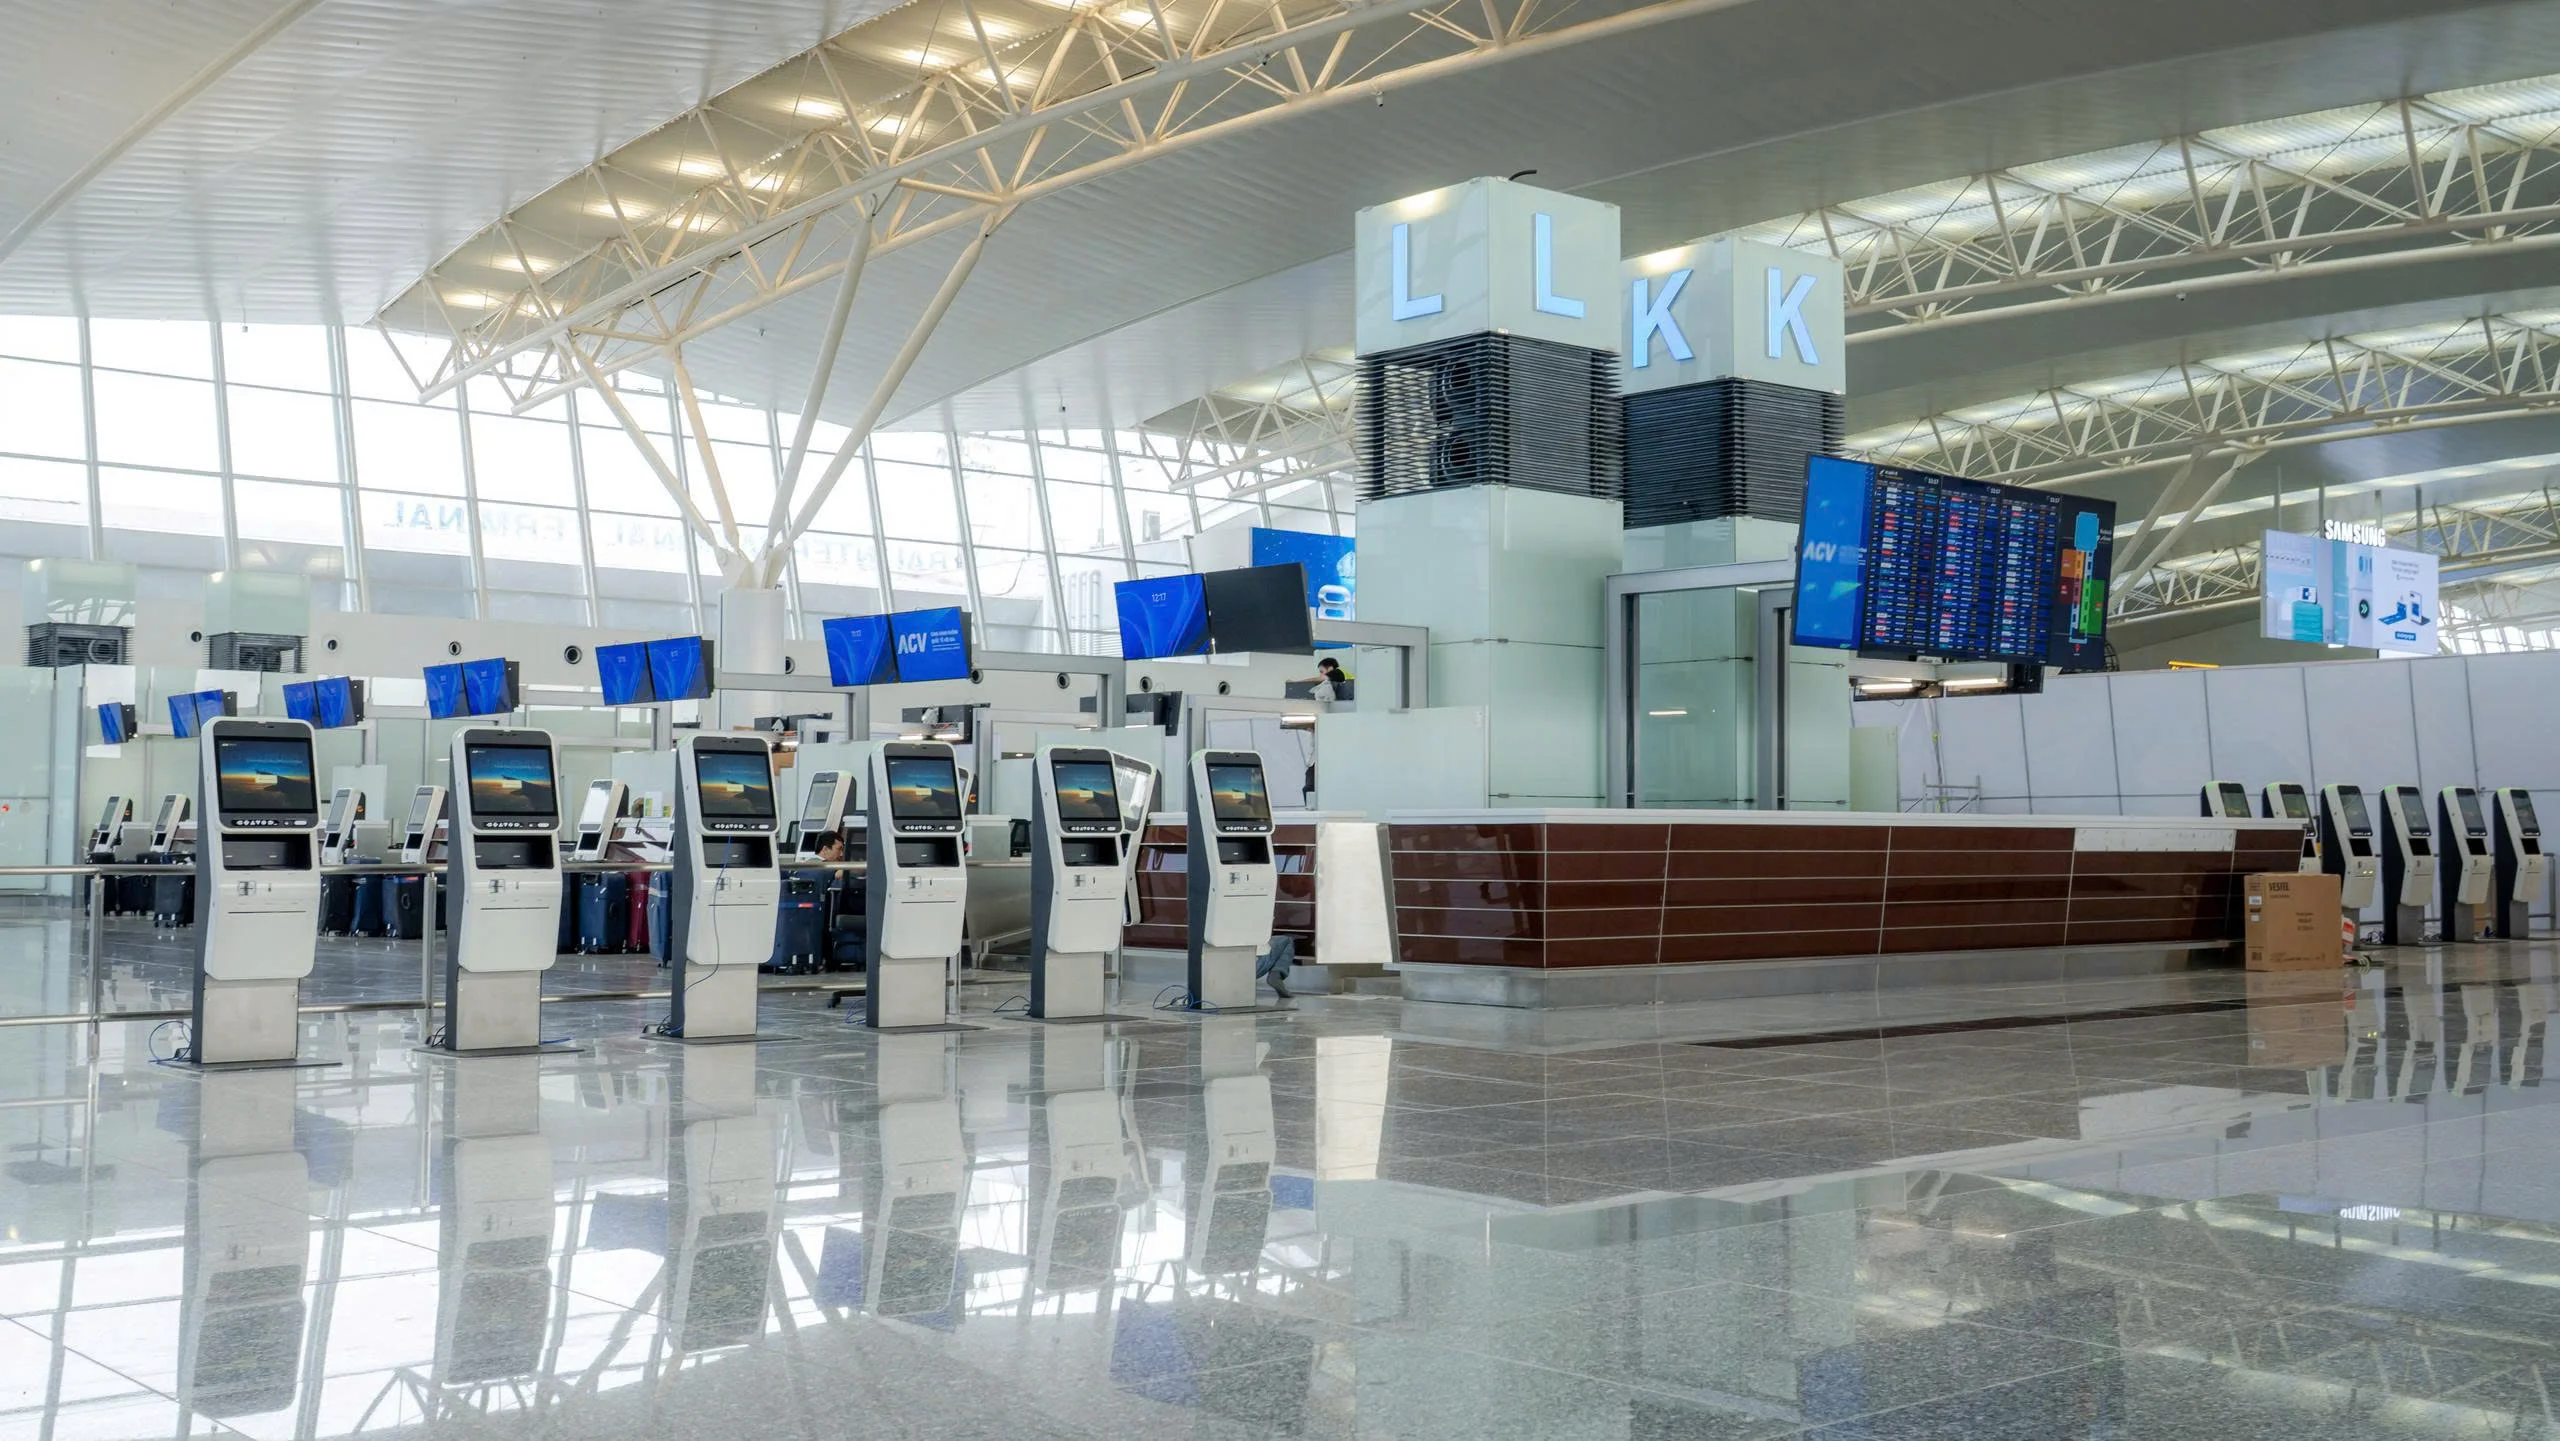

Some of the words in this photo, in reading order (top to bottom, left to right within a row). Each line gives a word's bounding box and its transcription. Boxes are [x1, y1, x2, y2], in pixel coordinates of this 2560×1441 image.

[1391, 222, 1444, 321] L
[1534, 212, 1586, 319] L
[1631, 267, 1696, 369] K
[1767, 266, 1820, 366] K
[2324, 519, 2387, 548] SAMSUNG
[897, 632, 928, 656] ACV
[2268, 882, 2291, 892] VESTEL
